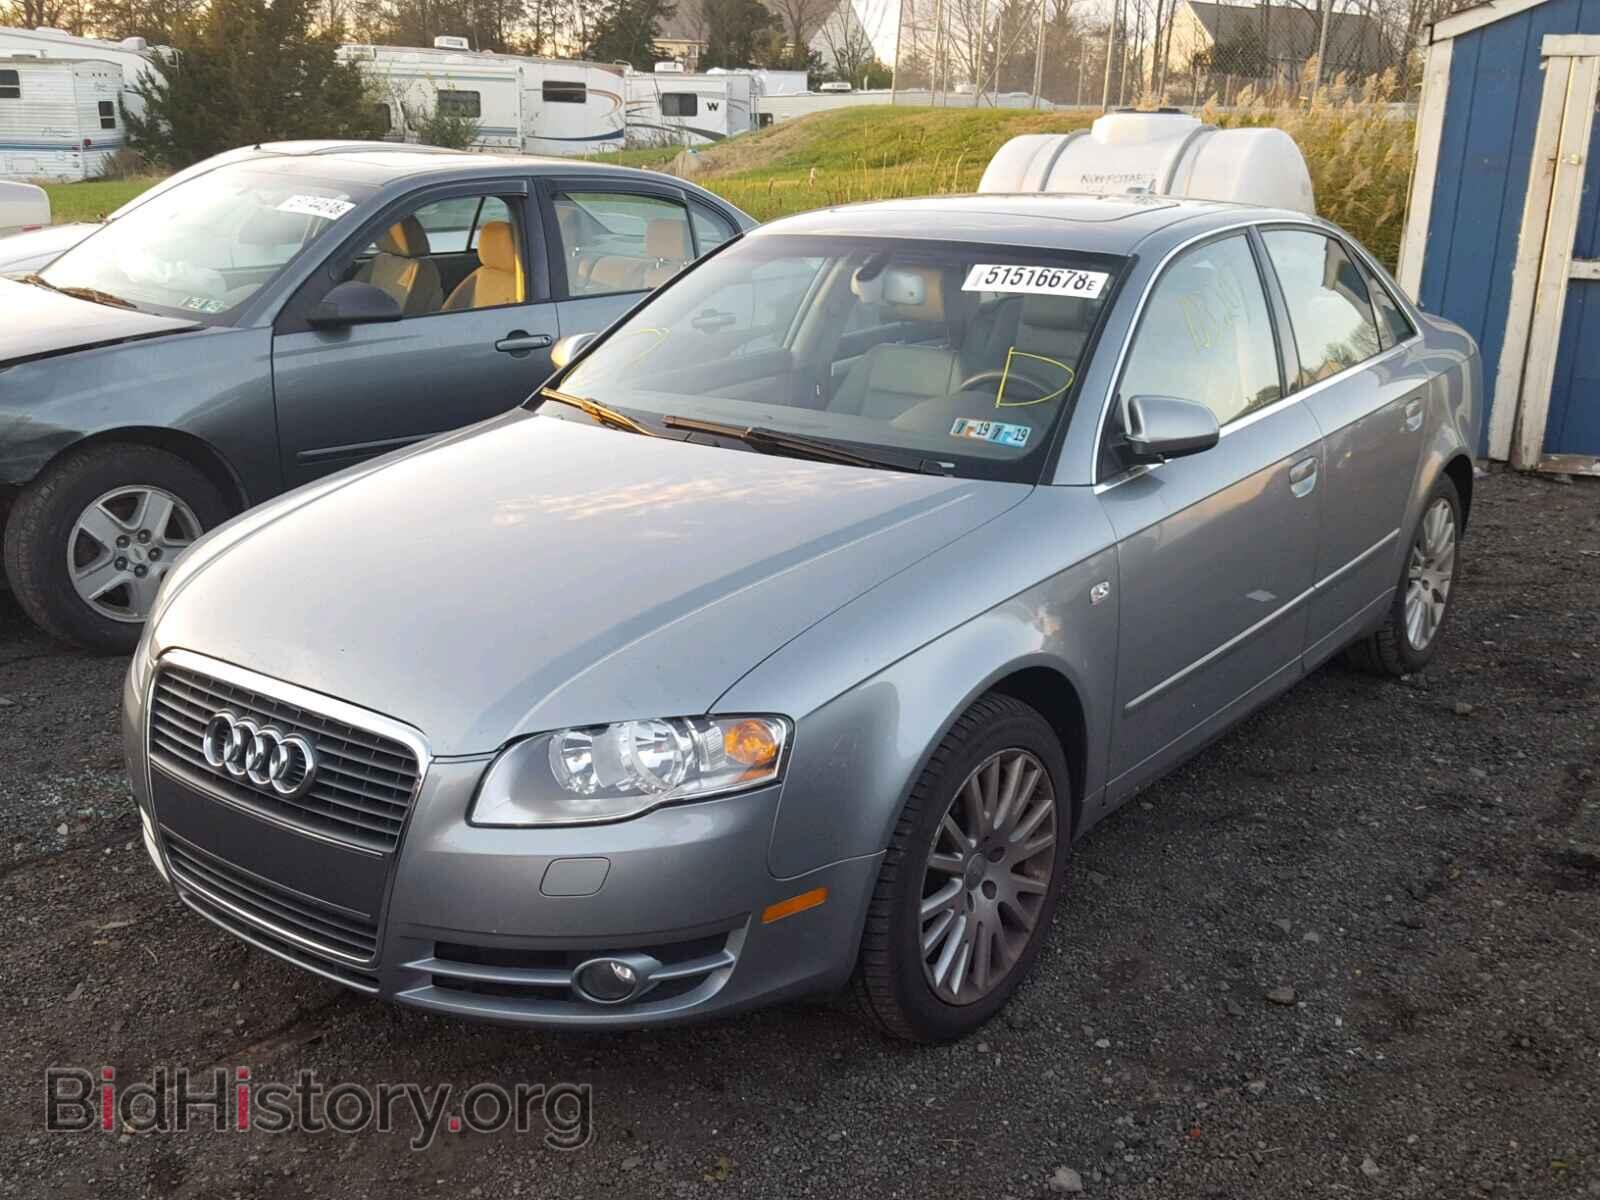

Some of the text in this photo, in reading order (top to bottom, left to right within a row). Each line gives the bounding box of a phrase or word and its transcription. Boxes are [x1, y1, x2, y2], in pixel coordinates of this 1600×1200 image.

[707, 102, 719, 112] W
[976, 422, 991, 436] 19
[1014, 428, 1028, 442] 19
